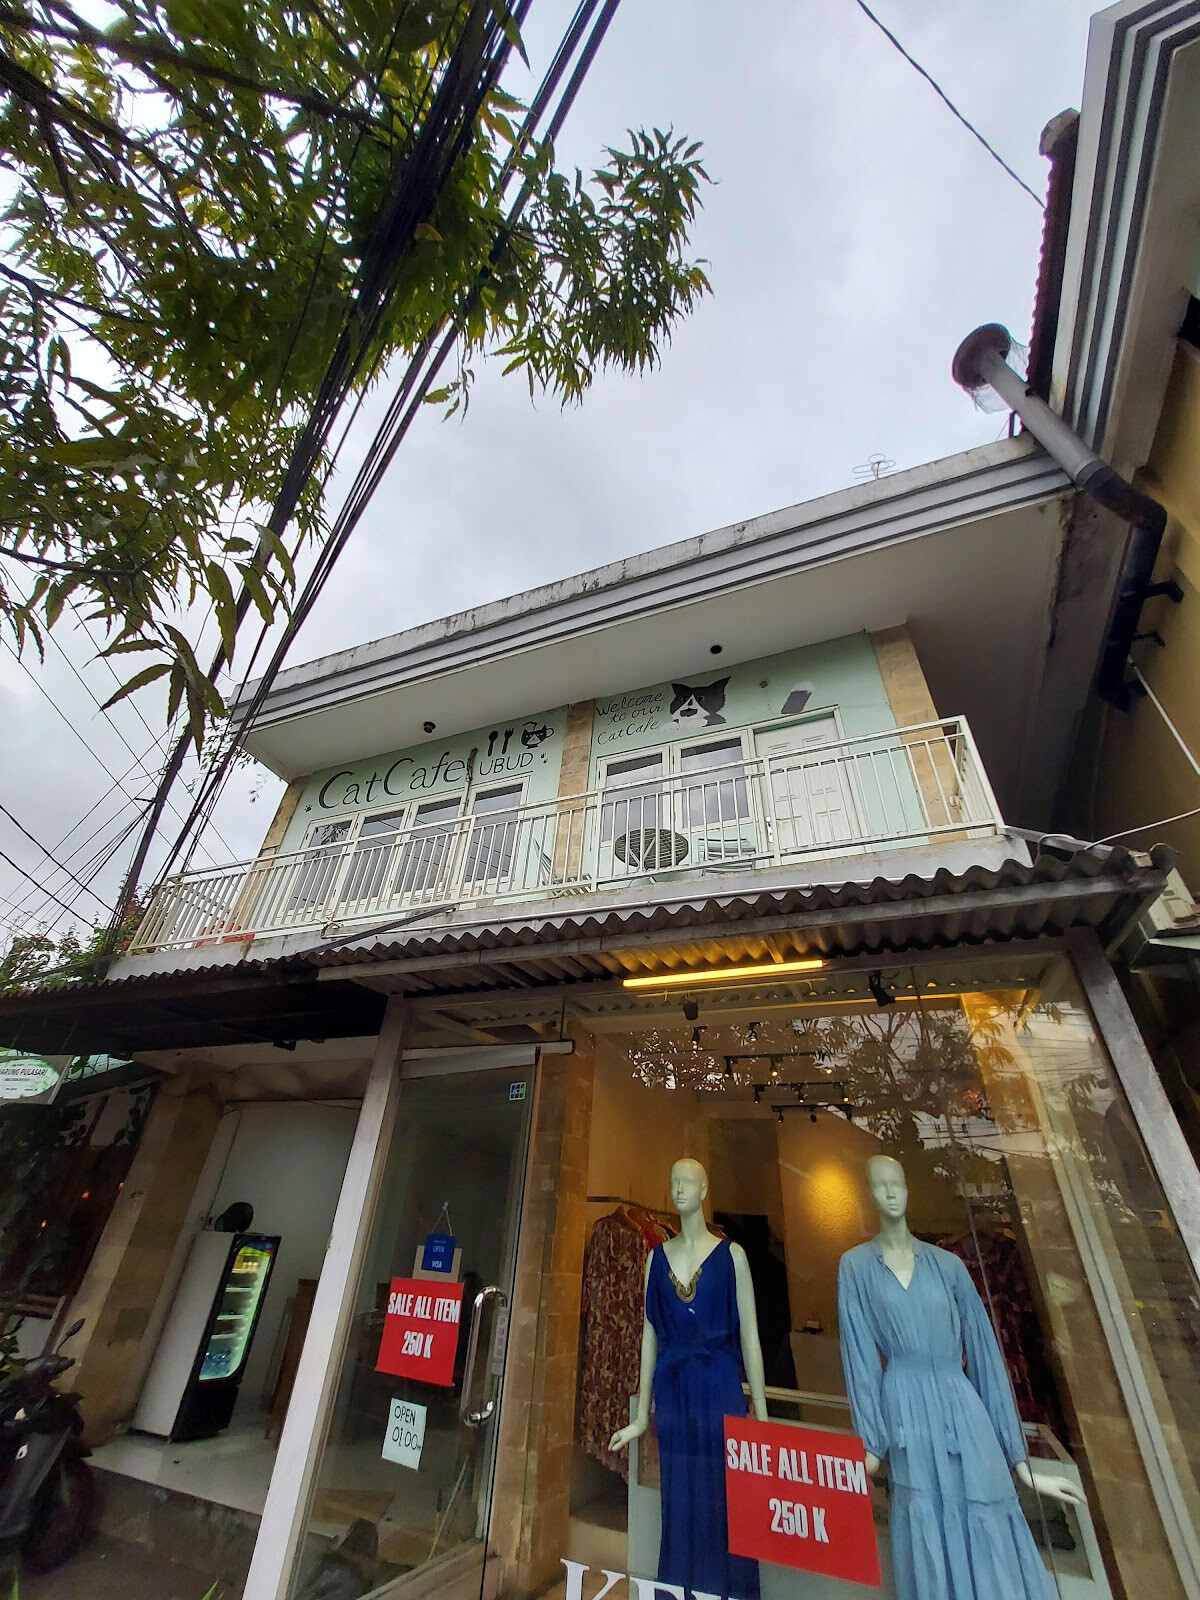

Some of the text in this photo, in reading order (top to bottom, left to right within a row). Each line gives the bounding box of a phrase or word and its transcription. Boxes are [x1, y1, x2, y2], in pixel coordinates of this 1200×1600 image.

[596, 692, 663, 716] Welcome
[608, 705, 664, 725] to our
[479, 752, 534, 776] UBUD
[387, 1292, 461, 1324] SALE ALL ITEM
[401, 1330, 434, 1359] 250 K
[394, 1405, 417, 1427] OPEN
[726, 1438, 868, 1495] SALE ALL ITEM
[769, 1498, 829, 1543] 250 K
